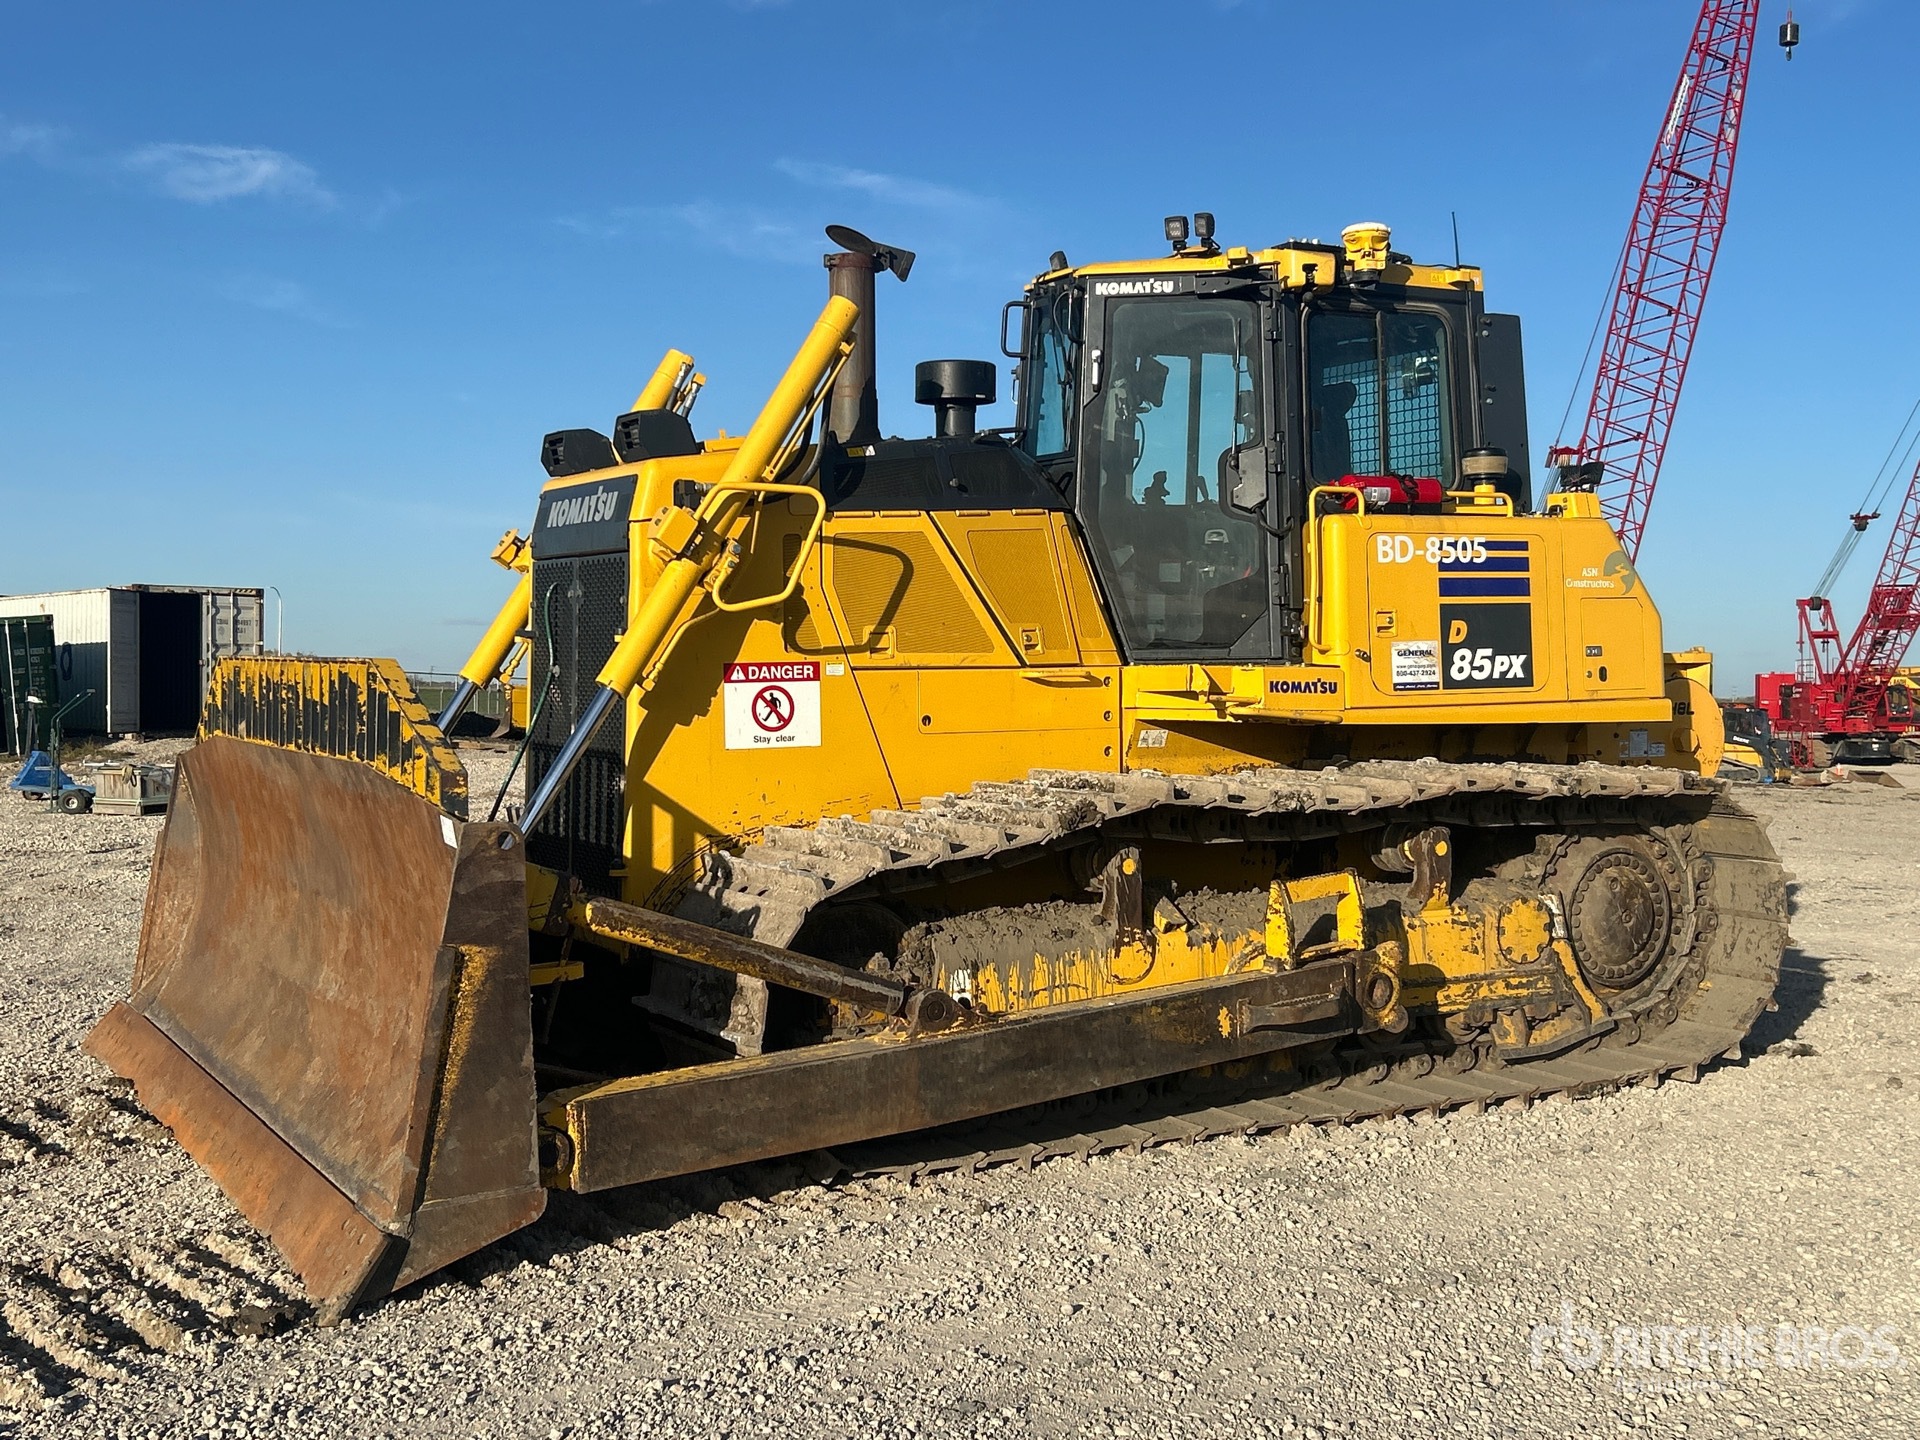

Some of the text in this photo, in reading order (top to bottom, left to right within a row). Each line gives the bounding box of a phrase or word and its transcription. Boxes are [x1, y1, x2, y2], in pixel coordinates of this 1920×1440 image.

[1095, 278, 1174, 295] KOMATSU
[546, 485, 619, 528] KOMATSU
[1376, 535, 1487, 564] BD-8505
[1581, 567, 1598, 577] ASN
[1565, 578, 1615, 588] Constructors
[1448, 619, 1468, 644] D
[1397, 649, 1433, 657] GENERAL
[1449, 647, 1527, 681] 85PX
[748, 665, 814, 680] DANGER
[1269, 678, 1338, 694] KOMATSU
[753, 735, 771, 744] Stay
